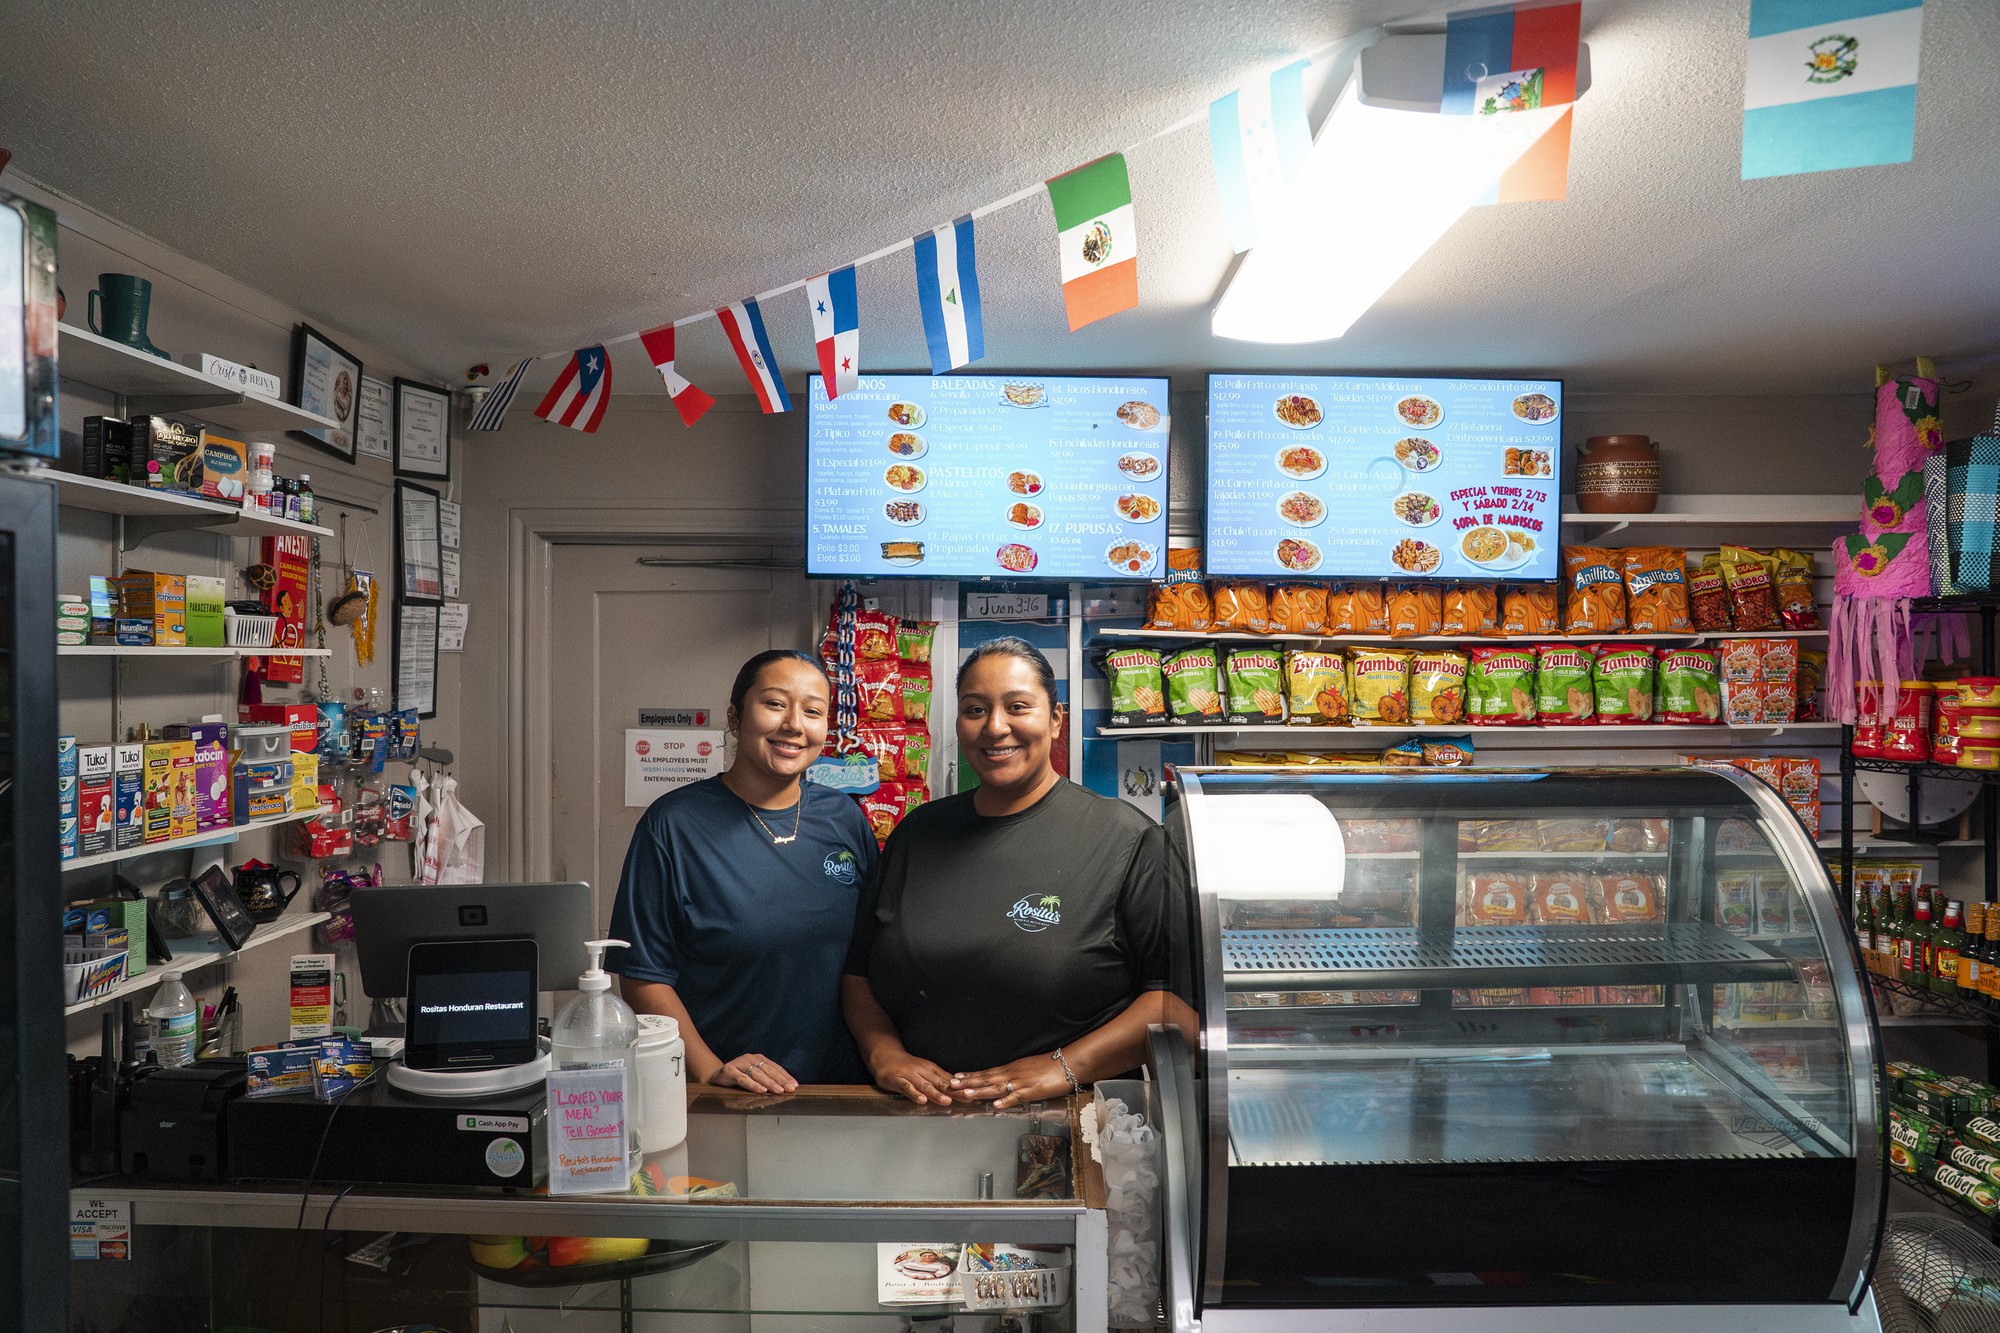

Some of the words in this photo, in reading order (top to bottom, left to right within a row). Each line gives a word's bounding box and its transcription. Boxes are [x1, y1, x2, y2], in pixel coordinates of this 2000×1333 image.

[209, 359, 237, 380] Cristo
[932, 380, 996, 390] BALEADAS
[1066, 385, 1091, 394] Tacos
[1225, 380, 1246, 390] Pollo
[1248, 381, 1271, 390] Frito
[1272, 381, 1290, 390] con
[1291, 382, 1318, 393] Papas
[1346, 381, 1374, 391] Carne
[1405, 383, 1423, 392] con
[1497, 383, 1519, 392] Frito
[1213, 392, 1240, 401] $12.99
[1332, 393, 1364, 404] Tajadas
[1225, 430, 1246, 440] Pollo
[1247, 431, 1271, 440] Frito
[1272, 431, 1289, 440] con
[1343, 424, 1371, 434] Carne
[1372, 425, 1402, 435] Asada
[1447, 433, 1522, 443] Centroamericana
[204, 448, 239, 462] CAMPHOR
[823, 458, 858, 469] Especial
[929, 466, 1005, 478] PASTELITOS
[1227, 478, 1255, 488] Carne
[1281, 480, 1299, 489] con
[1049, 493, 1075, 504] Papas
[1212, 490, 1246, 500] Tajadas
[1450, 486, 1488, 501] ESPECIAL
[1491, 486, 1522, 498] VIERNES
[1526, 489, 1548, 503] 2/13
[1462, 500, 1470, 512] Y
[1473, 495, 1508, 510] SÁBADO
[1511, 499, 1535, 513] 2/14
[812, 525, 821, 533] 5.
[822, 524, 867, 533] TAMALES
[1048, 523, 1063, 534] 17.
[1065, 522, 1124, 535] PUPUSAS
[1452, 516, 1480, 531] SOPA
[1482, 513, 1494, 526] DE
[1497, 513, 1544, 532] MARISCOS
[942, 531, 973, 543] Papas
[1223, 526, 1258, 536] Chuleta
[1259, 528, 1277, 536] con
[817, 544, 836, 552] Pollo
[838, 543, 860, 553] $3.00
[930, 543, 991, 555] Preparadas
[817, 554, 837, 562] Elote
[839, 553, 861, 563] $3.00
[1576, 567, 1621, 590] Anillitos
[1634, 570, 1681, 588] Anillitos
[189, 602, 223, 614] PARACETAMOL
[1730, 643, 1756, 657] Laky
[1767, 642, 1793, 657] Laky
[1107, 651, 1161, 674] Zambos
[1162, 654, 1215, 679] Zambos
[1229, 653, 1280, 675] Zambos
[1354, 655, 1408, 678] Zambos
[1411, 657, 1467, 678] Zambos
[1483, 655, 1535, 677] Zambos
[1599, 653, 1654, 676] Zambos
[1666, 655, 1714, 675] Zambo
[1735, 685, 1759, 700] Laky
[1767, 684, 1792, 699] Laky
[640, 713, 676, 726] Employees
[677, 713, 692, 726] Only
[1894, 721, 1916, 730] POLLO
[663, 742, 685, 750] STOP
[697, 745, 711, 753] STOP
[84, 753, 108, 767] Tukol
[120, 750, 140, 763] Tukol
[194, 749, 224, 763] tabcin
[247, 768, 275, 778] Sudagrip
[1750, 762, 1777, 777] Laky
[1788, 763, 1815, 777] Laky
[1797, 804, 1816, 819] aky
[1006, 900, 1061, 925] Rosita's
[421, 1005, 447, 1013] Rositas
[448, 1003, 483, 1012] Honduran
[485, 1001, 524, 1011] Restaurant
[565, 1105, 600, 1121] MEAL?
[494, 1120, 507, 1129] App
[508, 1121, 519, 1129] Pay
[563, 1125, 582, 1138] Tell
[1889, 1123, 1919, 1147] Clover
[1952, 1147, 1991, 1175] Clover
[570, 1164, 613, 1177] Restaurant
[1936, 1167, 1976, 1196] Clover
[90, 1200, 105, 1208] WE
[76, 1209, 119, 1219] ACCEPT
[72, 1225, 93, 1234] VISA
